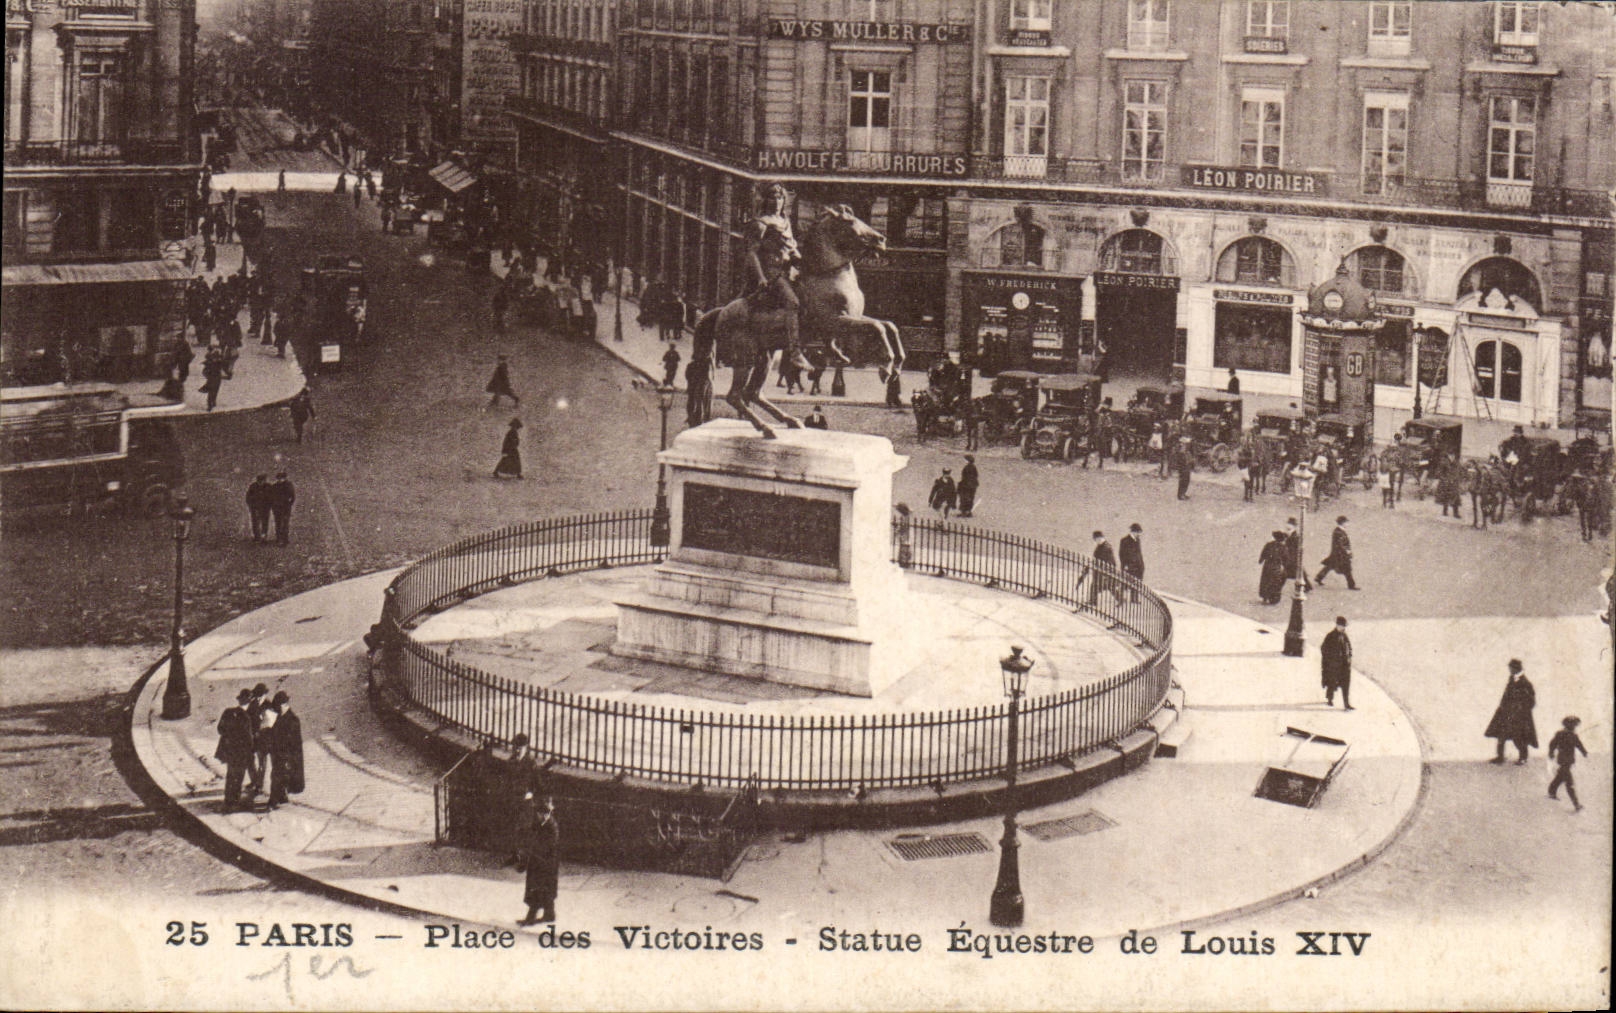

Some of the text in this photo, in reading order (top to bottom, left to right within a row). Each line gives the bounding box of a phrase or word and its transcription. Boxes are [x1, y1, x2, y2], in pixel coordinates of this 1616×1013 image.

[780, 20, 823, 38] WYS
[833, 22, 915, 40] MULLER
[1193, 168, 1315, 193] LÉON POIRIER
[1128, 276, 1176, 289] POIRIER
